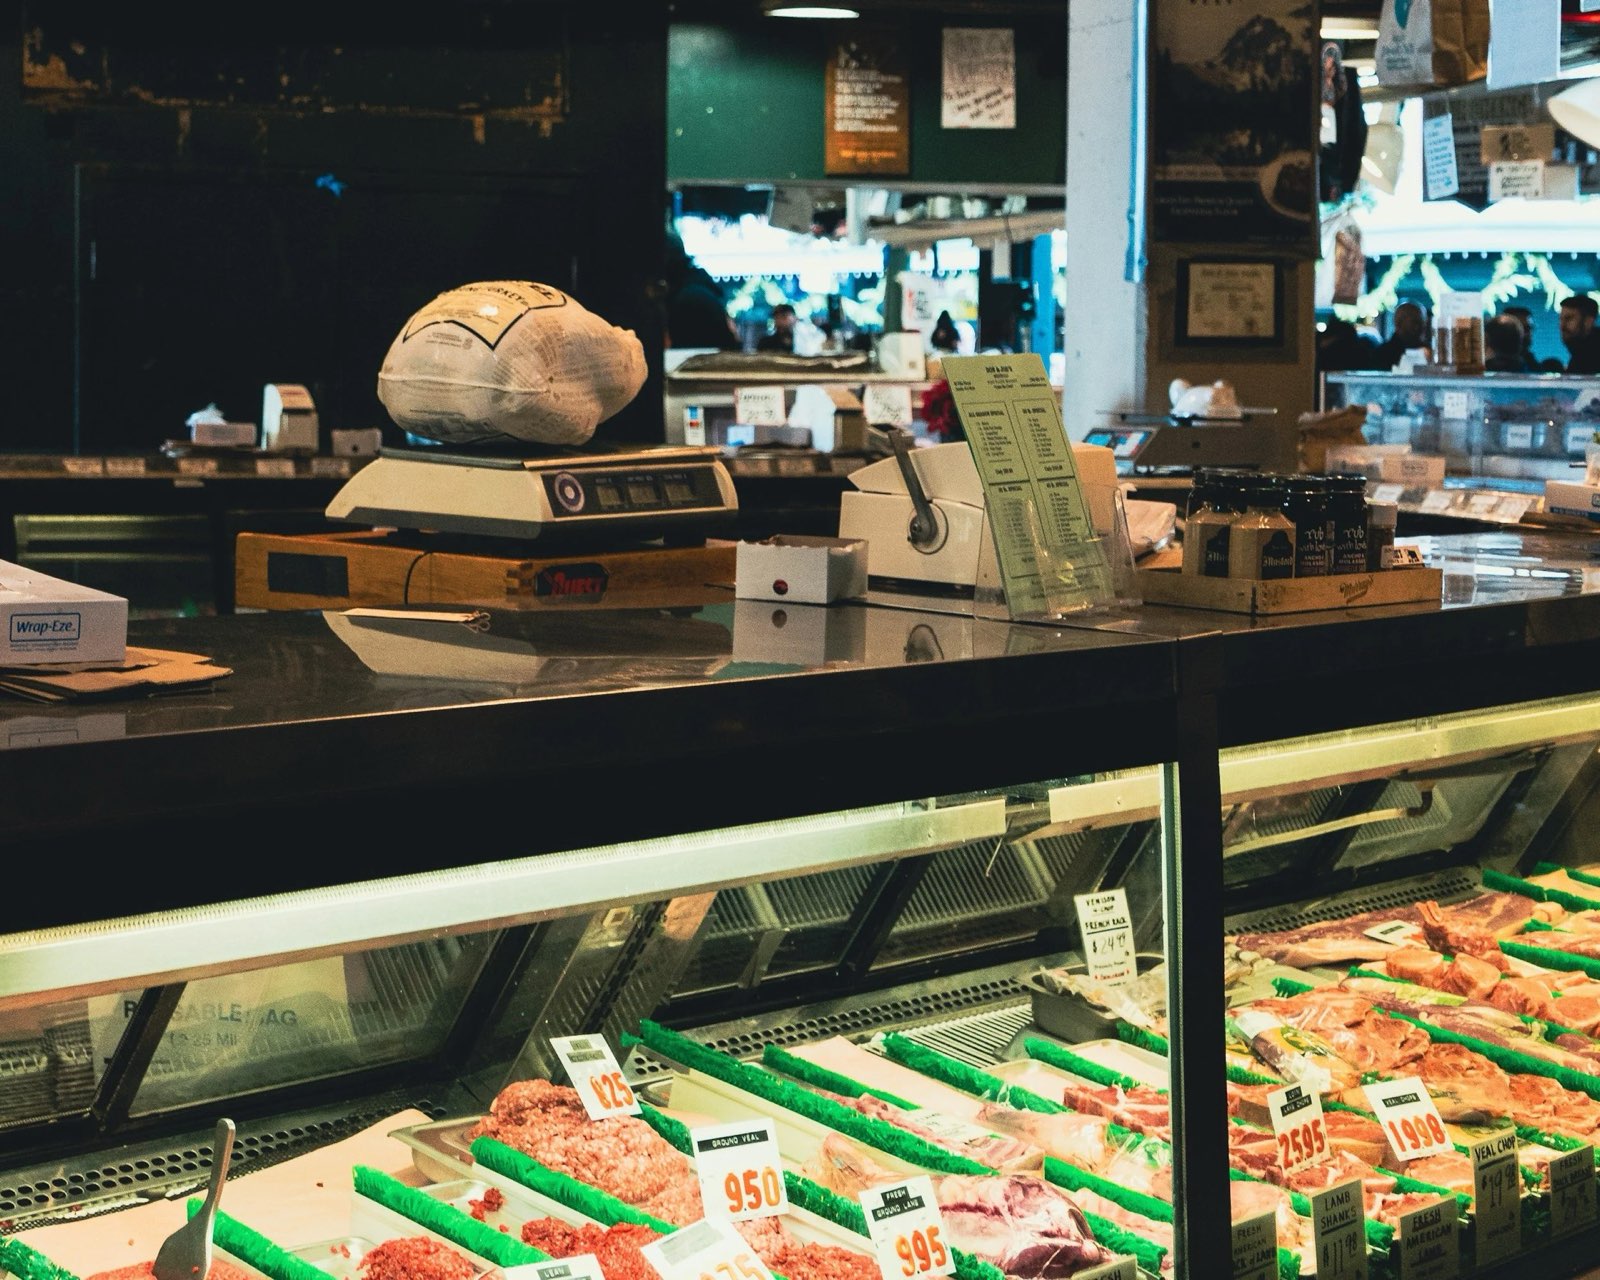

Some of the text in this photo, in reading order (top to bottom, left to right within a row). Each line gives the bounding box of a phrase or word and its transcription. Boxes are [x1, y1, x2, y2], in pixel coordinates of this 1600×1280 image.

[1343, 525, 1364, 539] rub
[16, 620, 73, 636] Wrap-Eze
[712, 1133, 760, 1148] GROUND VEAL
[1475, 1135, 1516, 1162] VEAL CHOP
[886, 1189, 906, 1200] FRESH
[1324, 1191, 1351, 1211] LAMB
[876, 1199, 919, 1218] GROUND LAMB
[1320, 1206, 1357, 1230] SHANKS
[1413, 1208, 1441, 1230] FRESH
[1236, 1225, 1262, 1240] FRESH
[1406, 1223, 1452, 1250] AMERICAN
